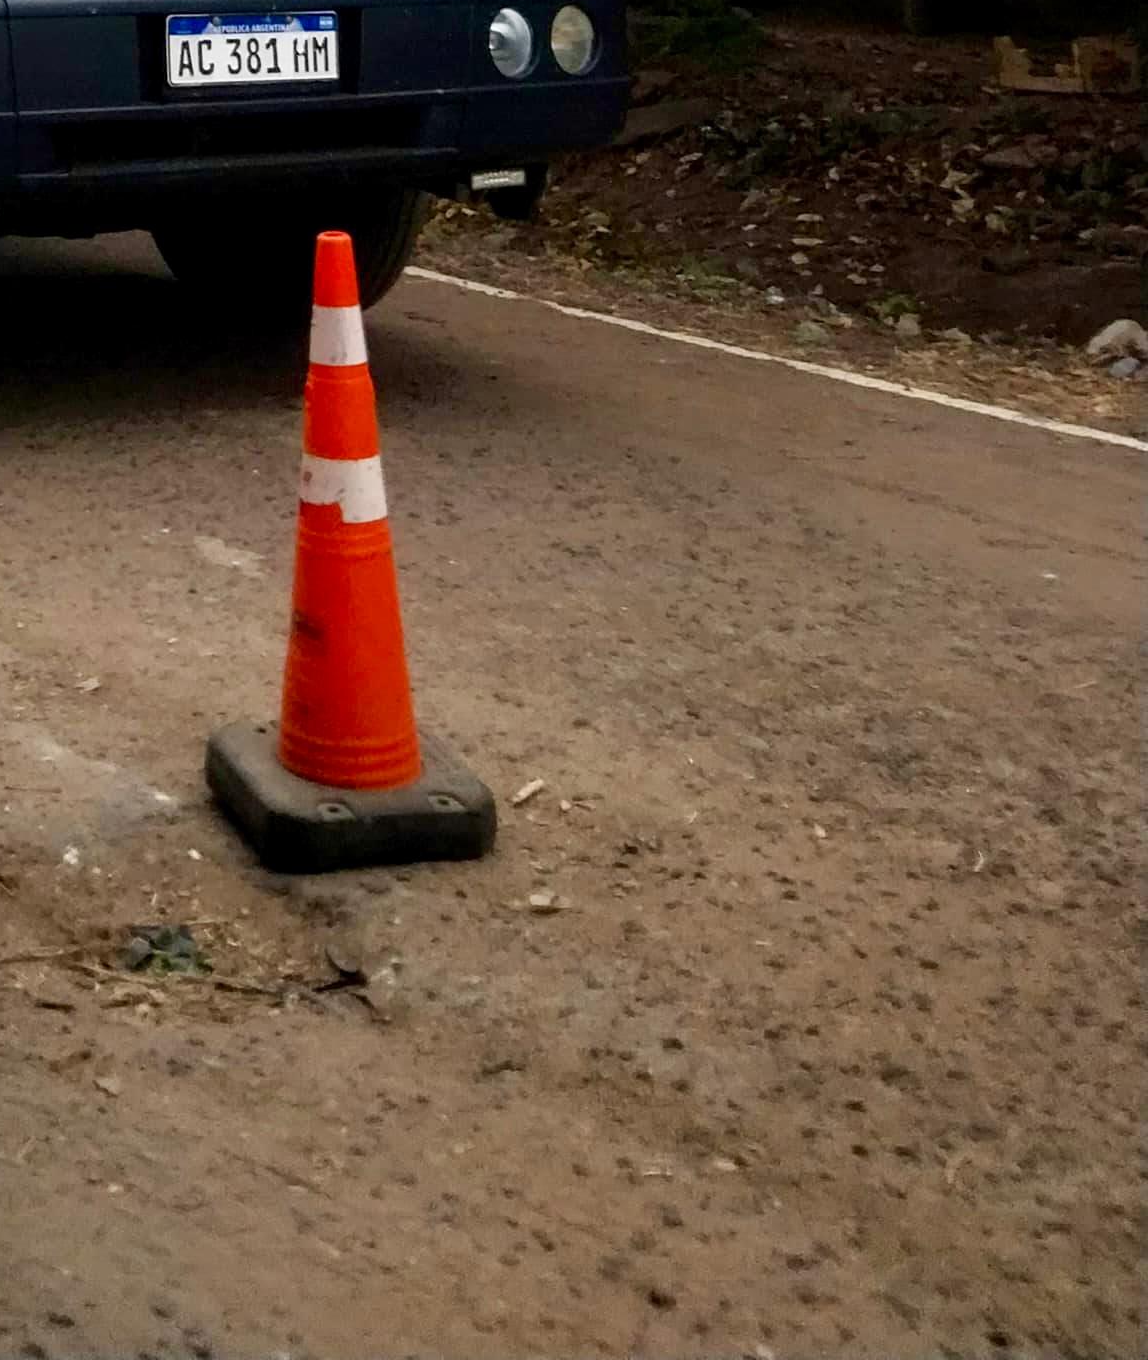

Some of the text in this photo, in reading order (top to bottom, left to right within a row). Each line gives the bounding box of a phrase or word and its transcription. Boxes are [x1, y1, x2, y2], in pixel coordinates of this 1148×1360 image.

[179, 37, 329, 76] AC 381 HM
